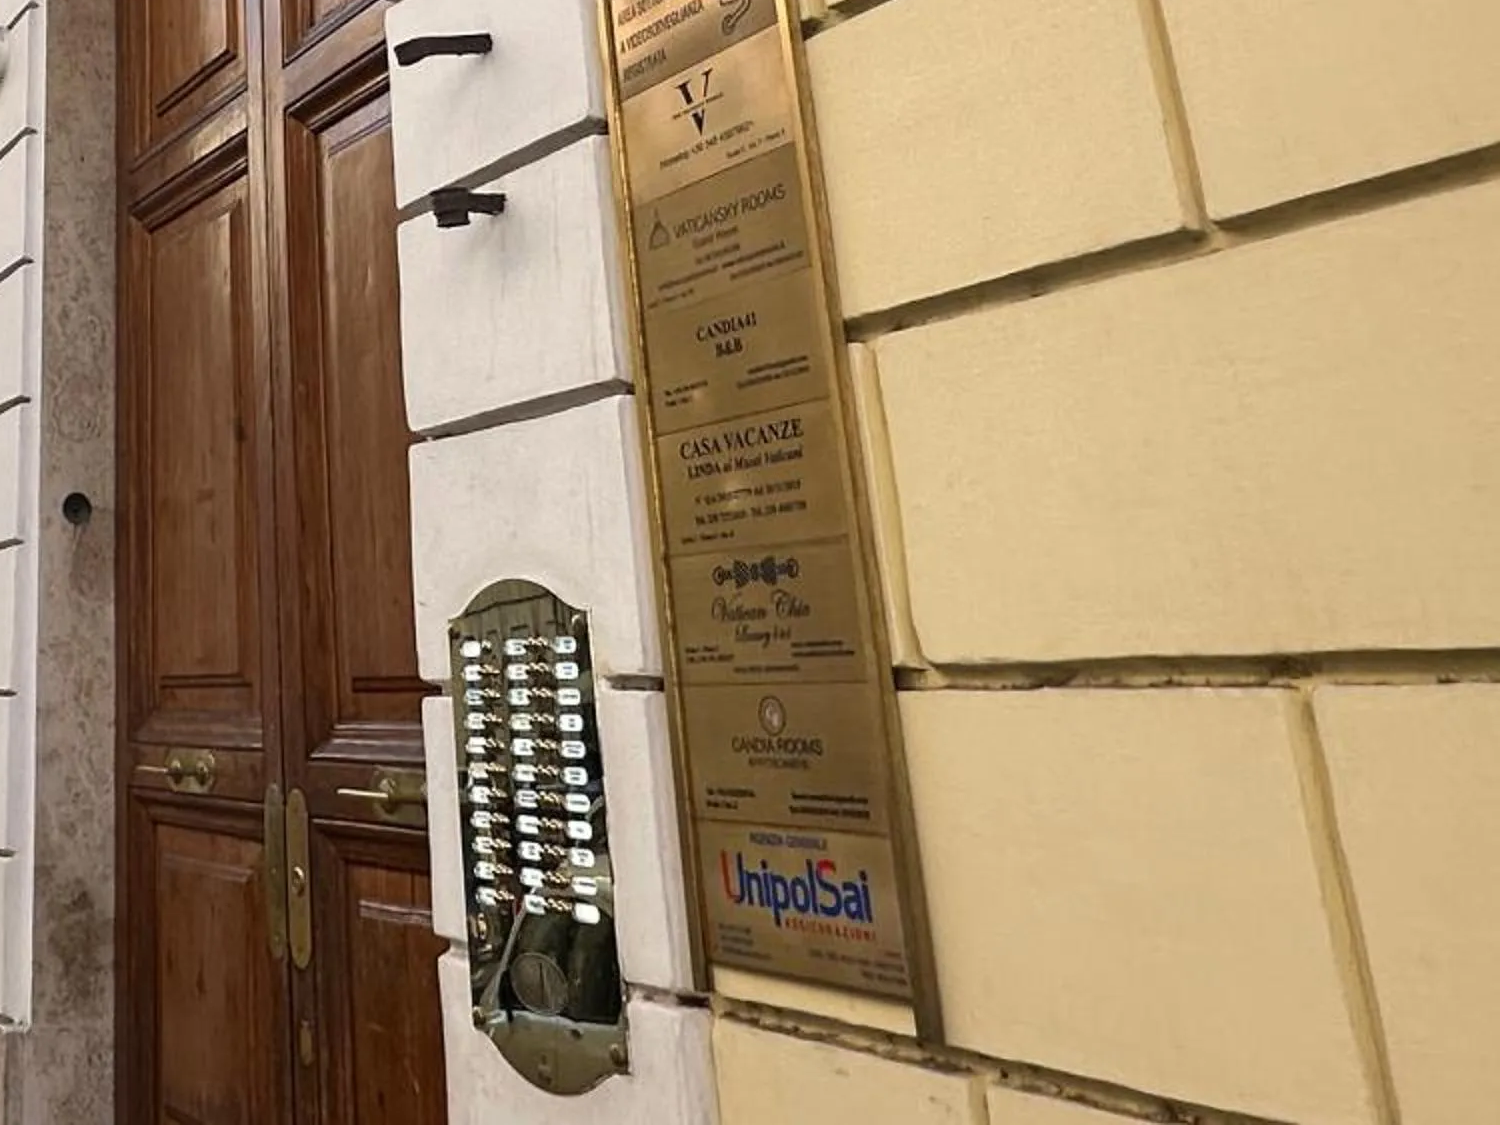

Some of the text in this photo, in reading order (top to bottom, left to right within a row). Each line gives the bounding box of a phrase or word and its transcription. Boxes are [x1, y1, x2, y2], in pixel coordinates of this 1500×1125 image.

[740, 182, 786, 214] ROOMS
[679, 418, 805, 461] CASA VACANZE
[720, 849, 873, 928] UnipolSai
